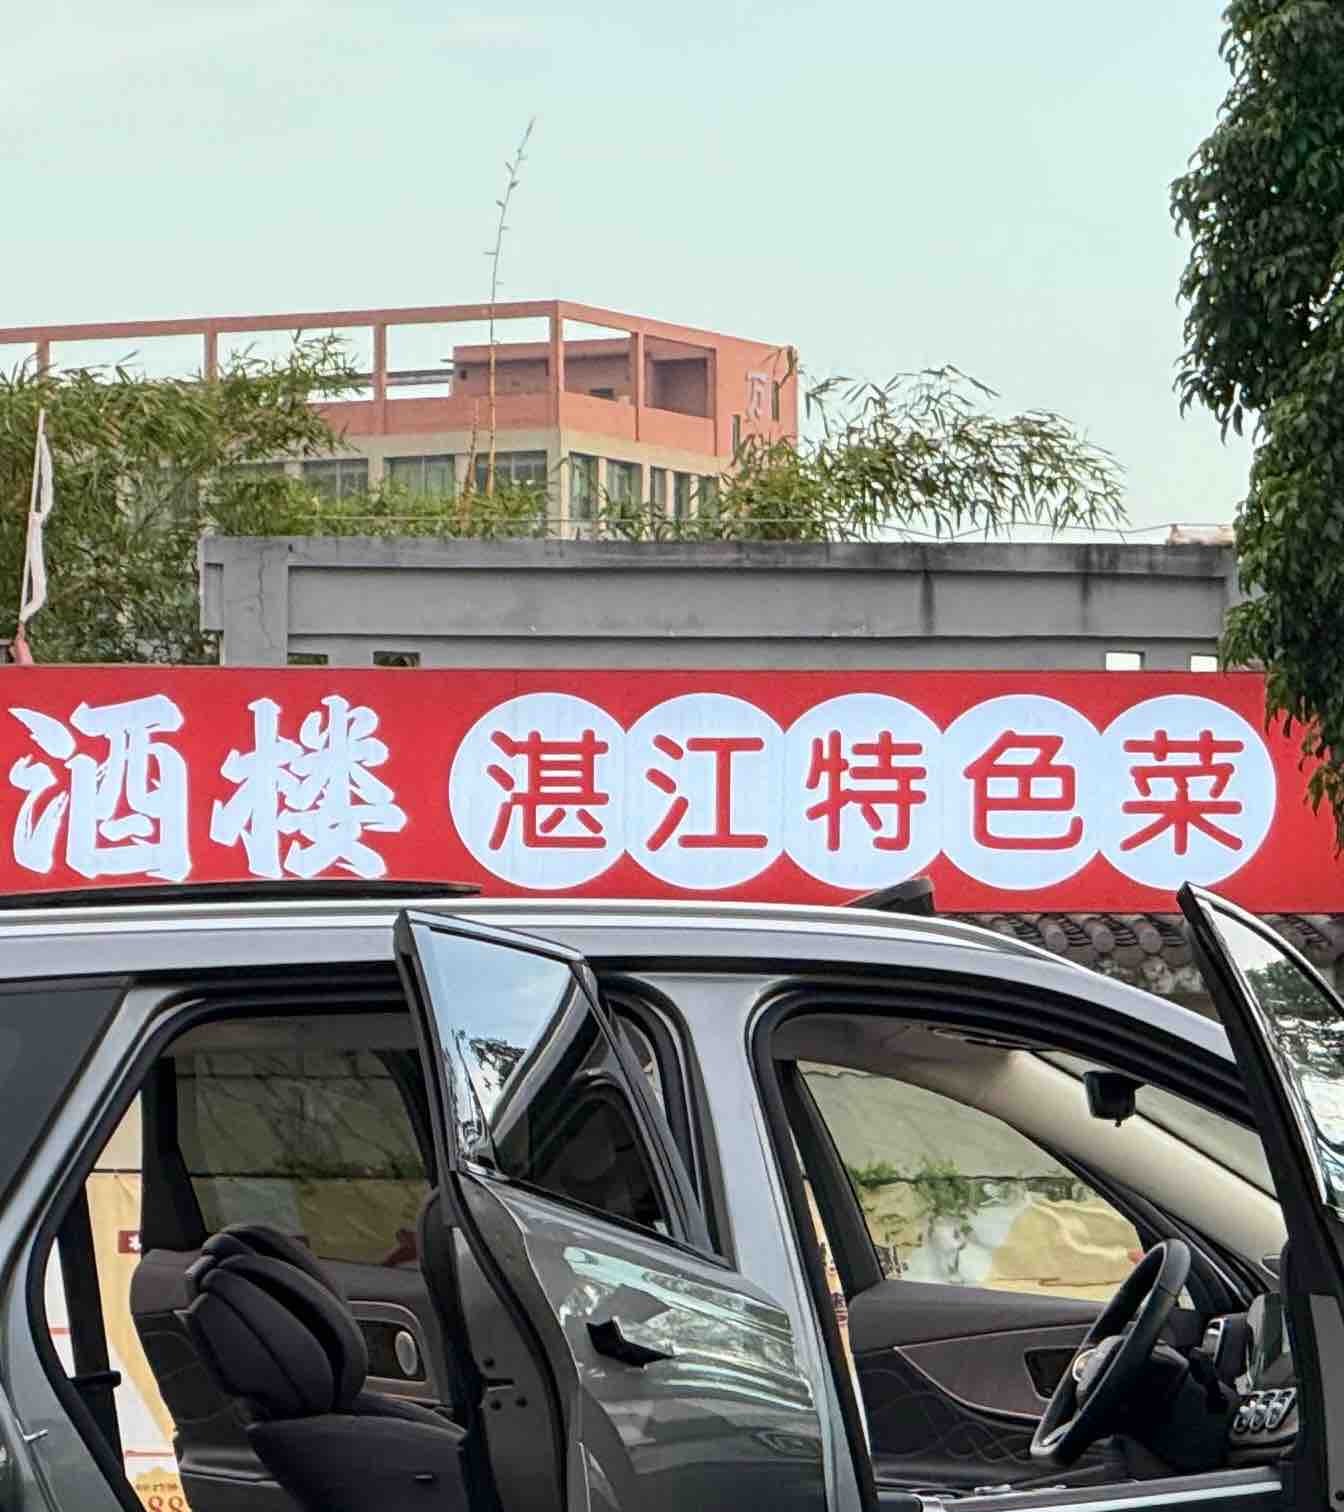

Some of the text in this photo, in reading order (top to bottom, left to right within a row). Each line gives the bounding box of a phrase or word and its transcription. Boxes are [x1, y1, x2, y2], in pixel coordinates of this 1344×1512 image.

[486, 729, 1244, 855] 湛江特色菜
